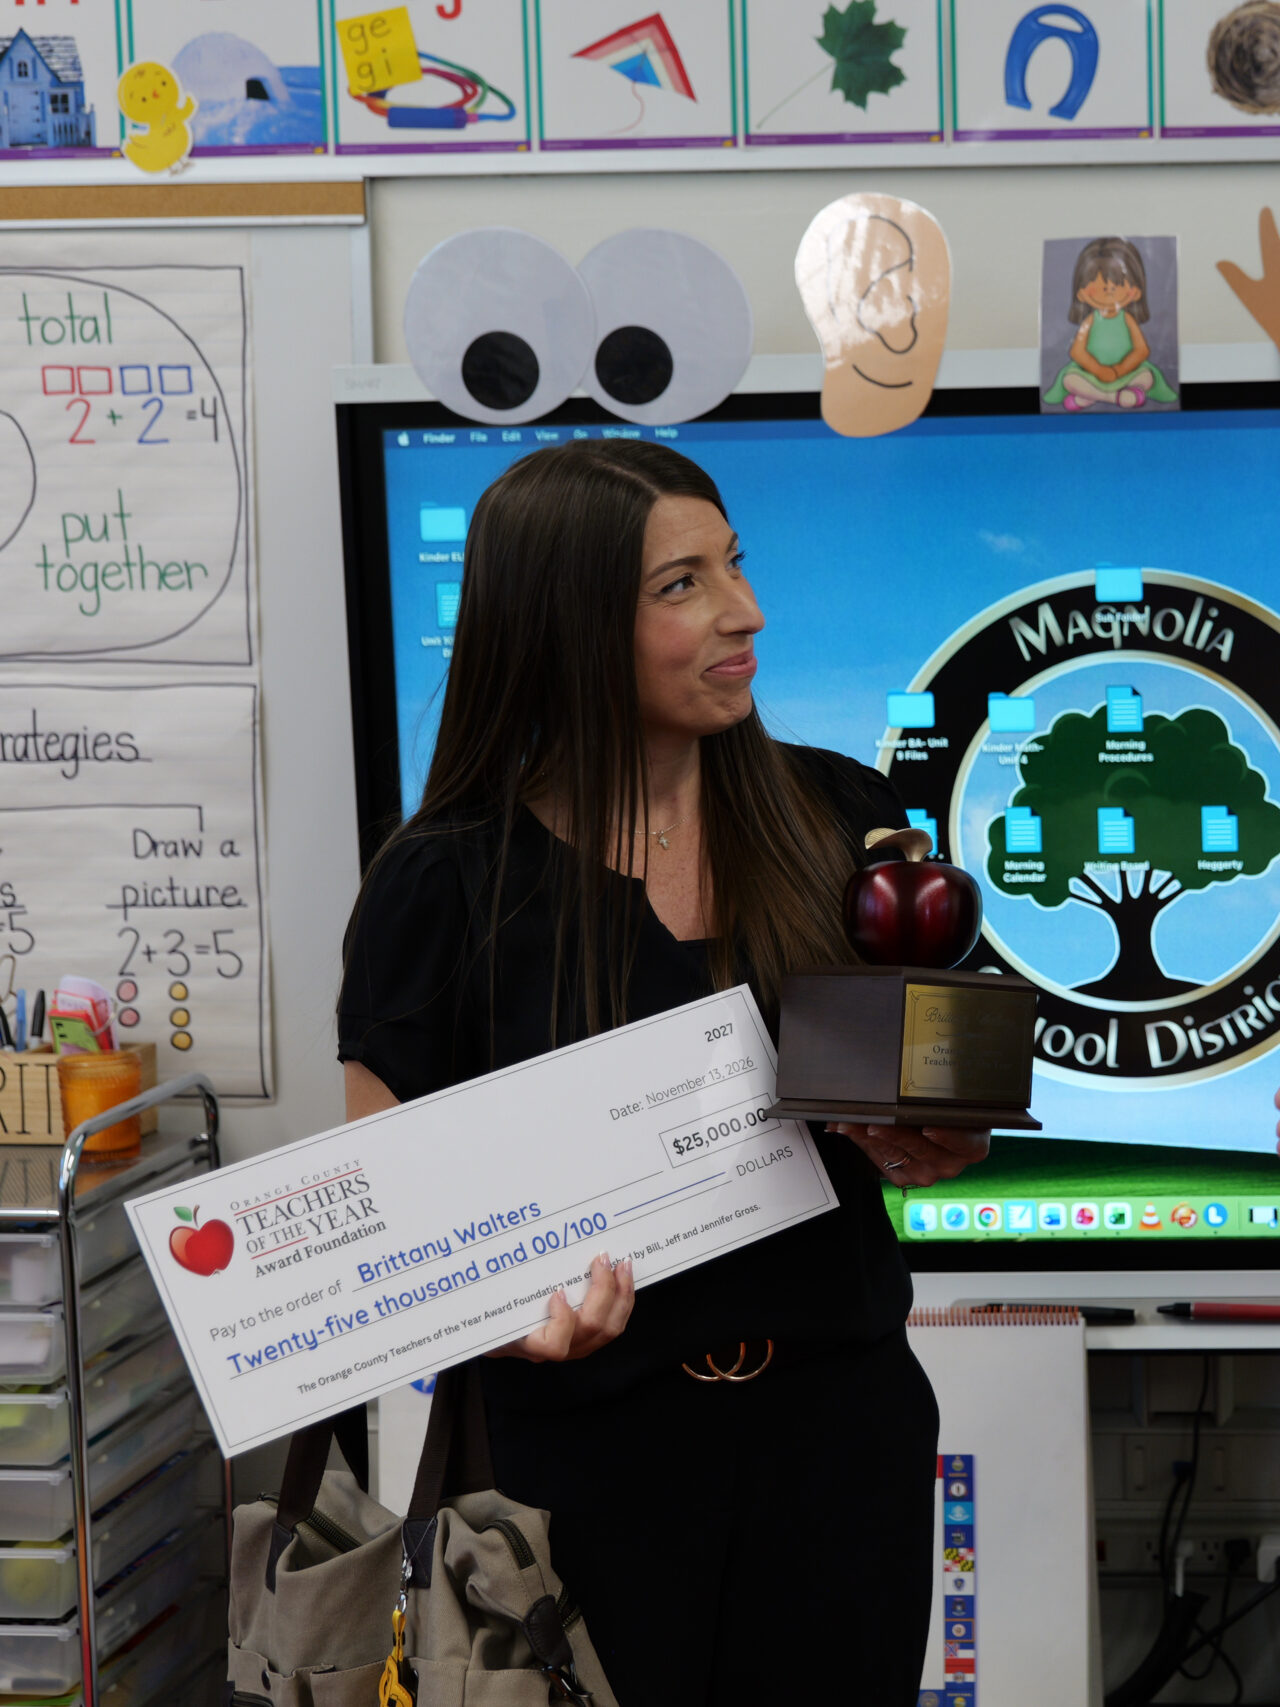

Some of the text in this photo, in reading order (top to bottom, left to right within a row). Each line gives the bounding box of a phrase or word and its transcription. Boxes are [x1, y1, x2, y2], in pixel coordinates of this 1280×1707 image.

[347, 14, 392, 56] ge
[18, 291, 113, 345] total
[423, 433, 456, 444] Finder
[470, 431, 488, 443] File
[502, 430, 522, 442] Edit
[535, 430, 559, 441] View
[655, 427, 678, 440] Help
[62, 488, 133, 558] put
[35, 543, 208, 617] together
[1098, 752, 1155, 763] Procedures
[1105, 739, 1147, 751] Morning
[133, 828, 240, 859] Draw a
[1004, 860, 1045, 873] Morning
[1197, 860, 1244, 872] Heggerty
[121, 876, 243, 922] picture
[1002, 872, 1047, 884] Calendar
[704, 1022, 734, 1042] 2027
[610, 1102, 645, 1121] Date:
[645, 1074, 706, 1105] November
[725, 1056, 754, 1076] 2026
[672, 1108, 769, 1156] $25,000.00
[230, 1159, 361, 1211] ORANGE COUNTY
[736, 1145, 794, 1177] DOLLARS
[236, 1173, 370, 1236] TEACHERS
[246, 1197, 380, 1254] OF THE YEAR
[255, 1221, 387, 1278] Award Foundation
[357, 1202, 541, 1283] Brittany Walters
[634, 1203, 761, 1260] by Bill, Jeff and Jennifer Gross.
[209, 1279, 343, 1342] Pay to the order of
[226, 1309, 370, 1374] Twenty-five
[374, 1260, 481, 1318] thousand
[486, 1242, 528, 1274] and
[532, 1212, 608, 1255] 00/100
[297, 1381, 318, 1395] The
[318, 1366, 353, 1386] Orange
[354, 1352, 389, 1371] County
[389, 1334, 433, 1358] Teachers
[433, 1328, 443, 1341] of
[444, 1322, 460, 1336] the
[460, 1313, 483, 1330] Year
[484, 1301, 513, 1321] Award
[565, 1275, 583, 1288] was
